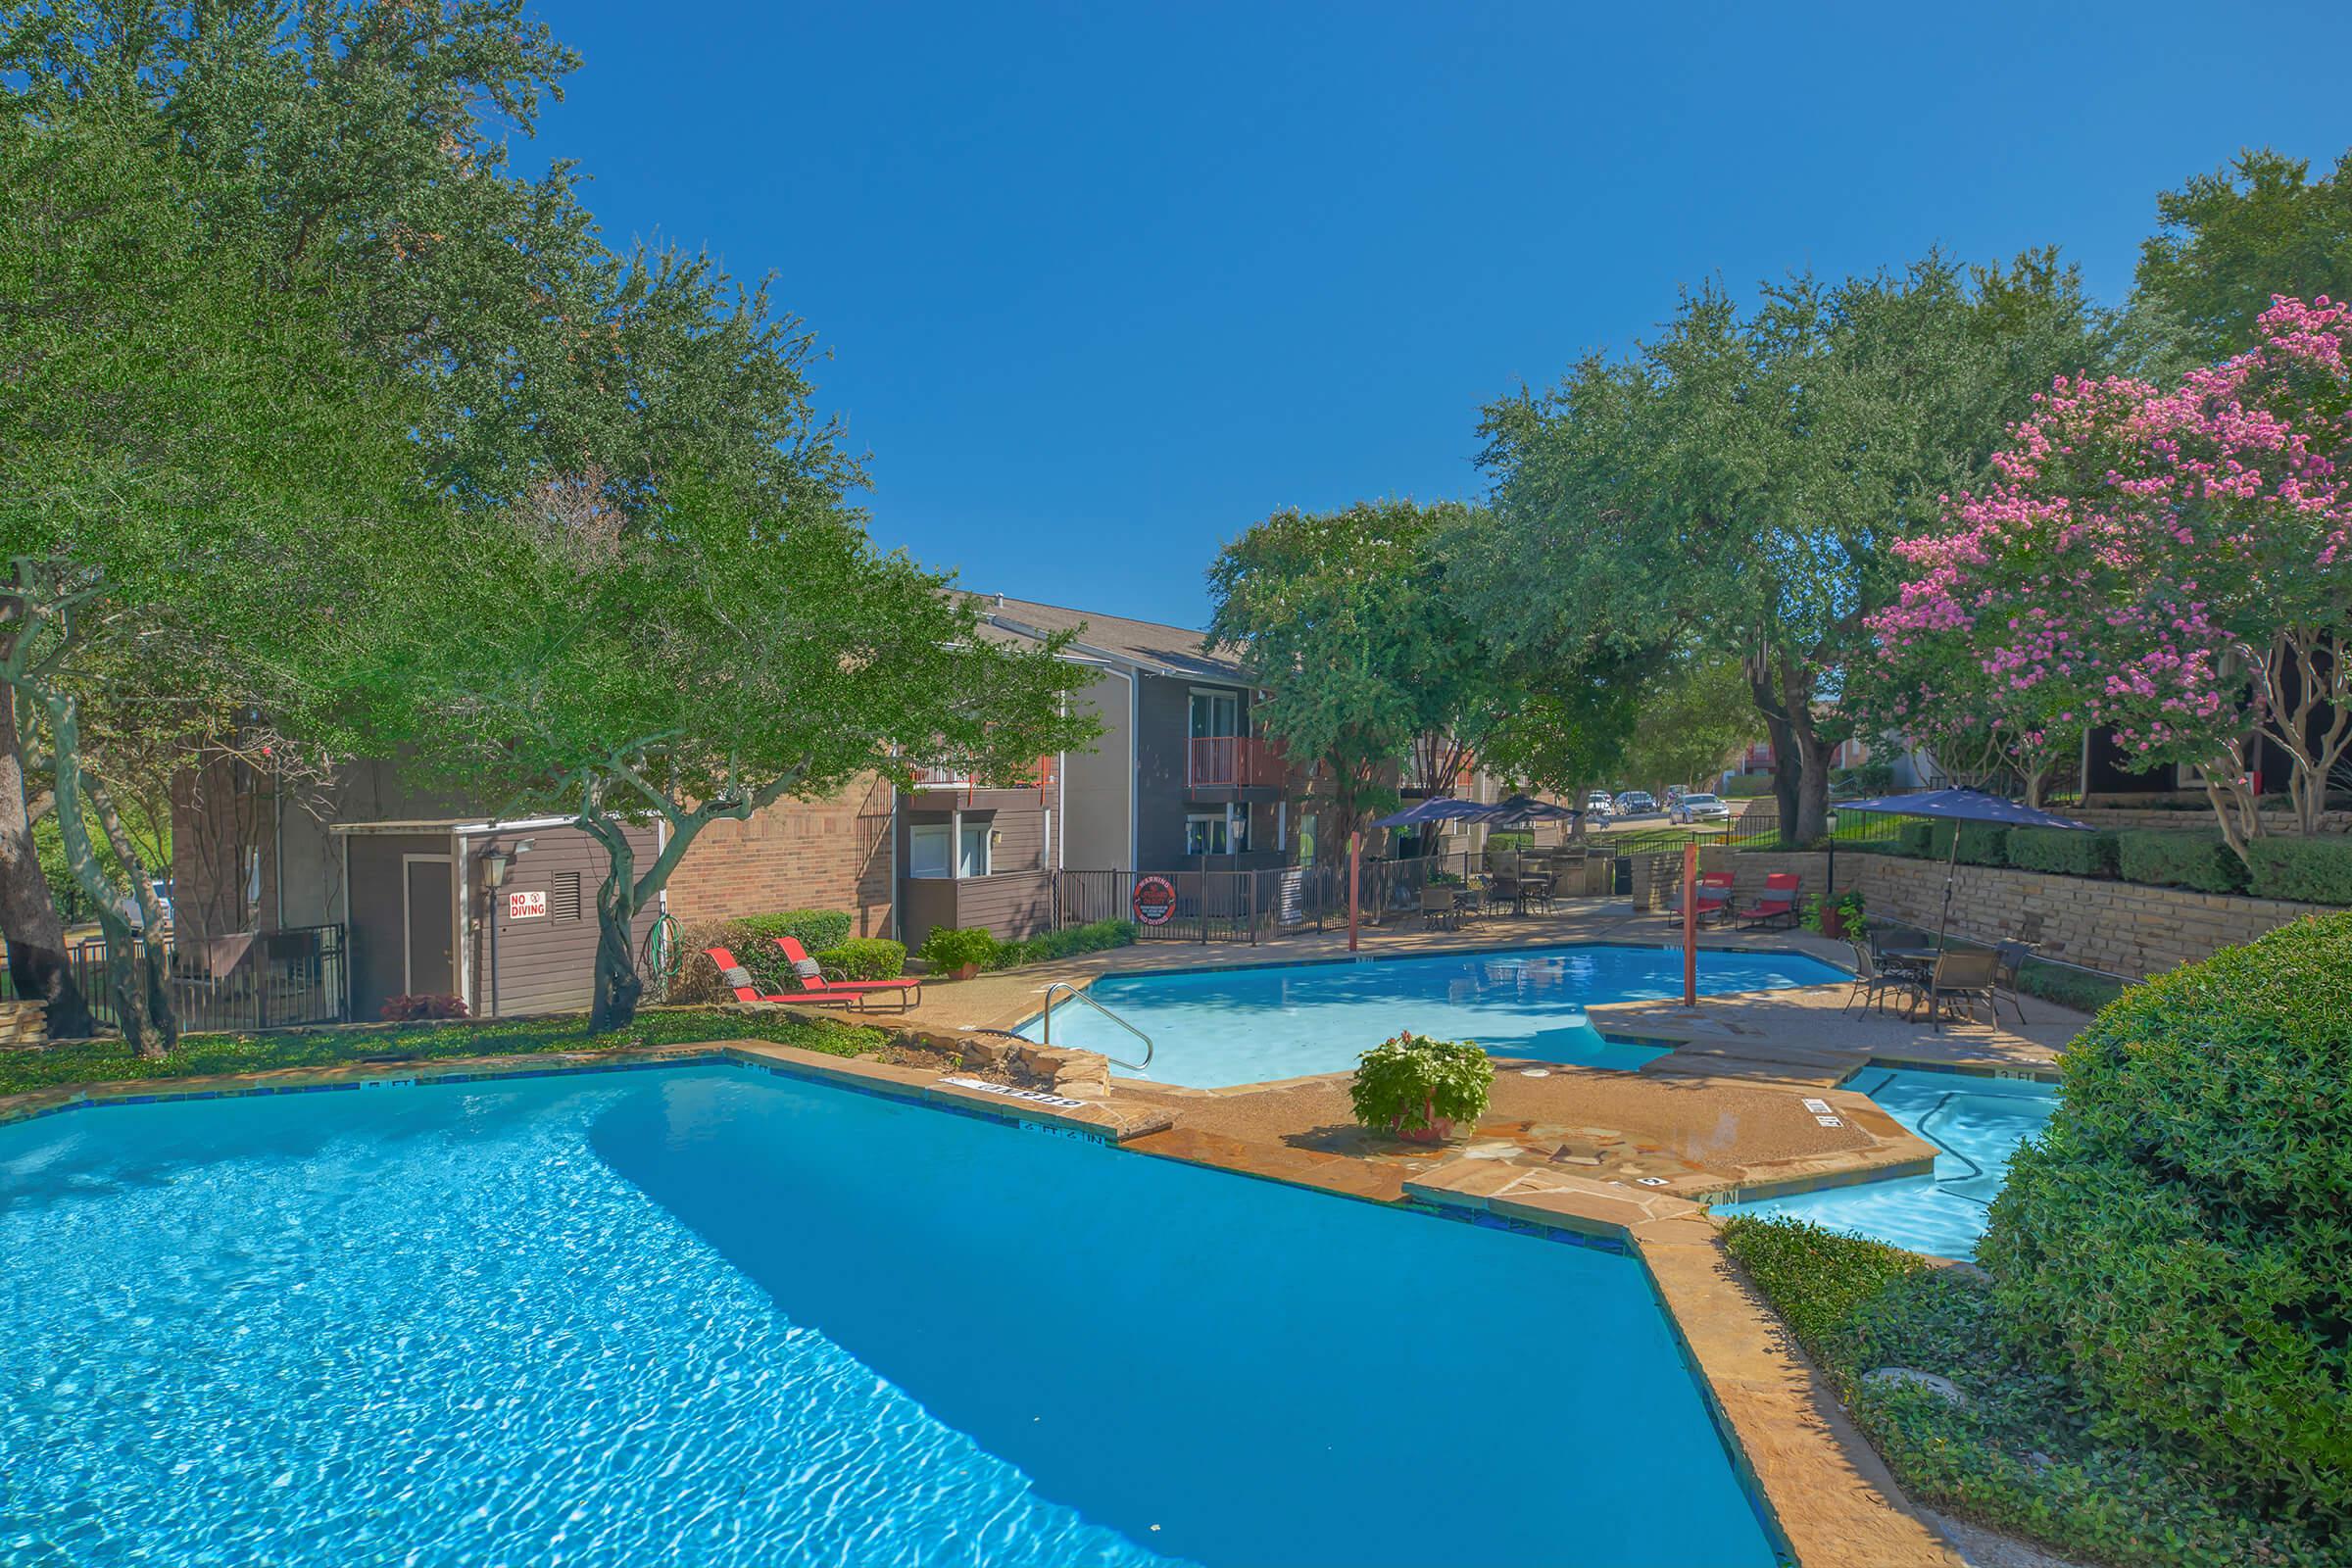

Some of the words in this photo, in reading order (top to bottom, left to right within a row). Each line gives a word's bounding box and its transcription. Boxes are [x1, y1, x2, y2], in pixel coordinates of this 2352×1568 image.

[512, 895, 525, 906] NO
[512, 904, 545, 917] DIVING
[1087, 1133, 1102, 1145] IN
[1723, 1191, 1737, 1206] IN
